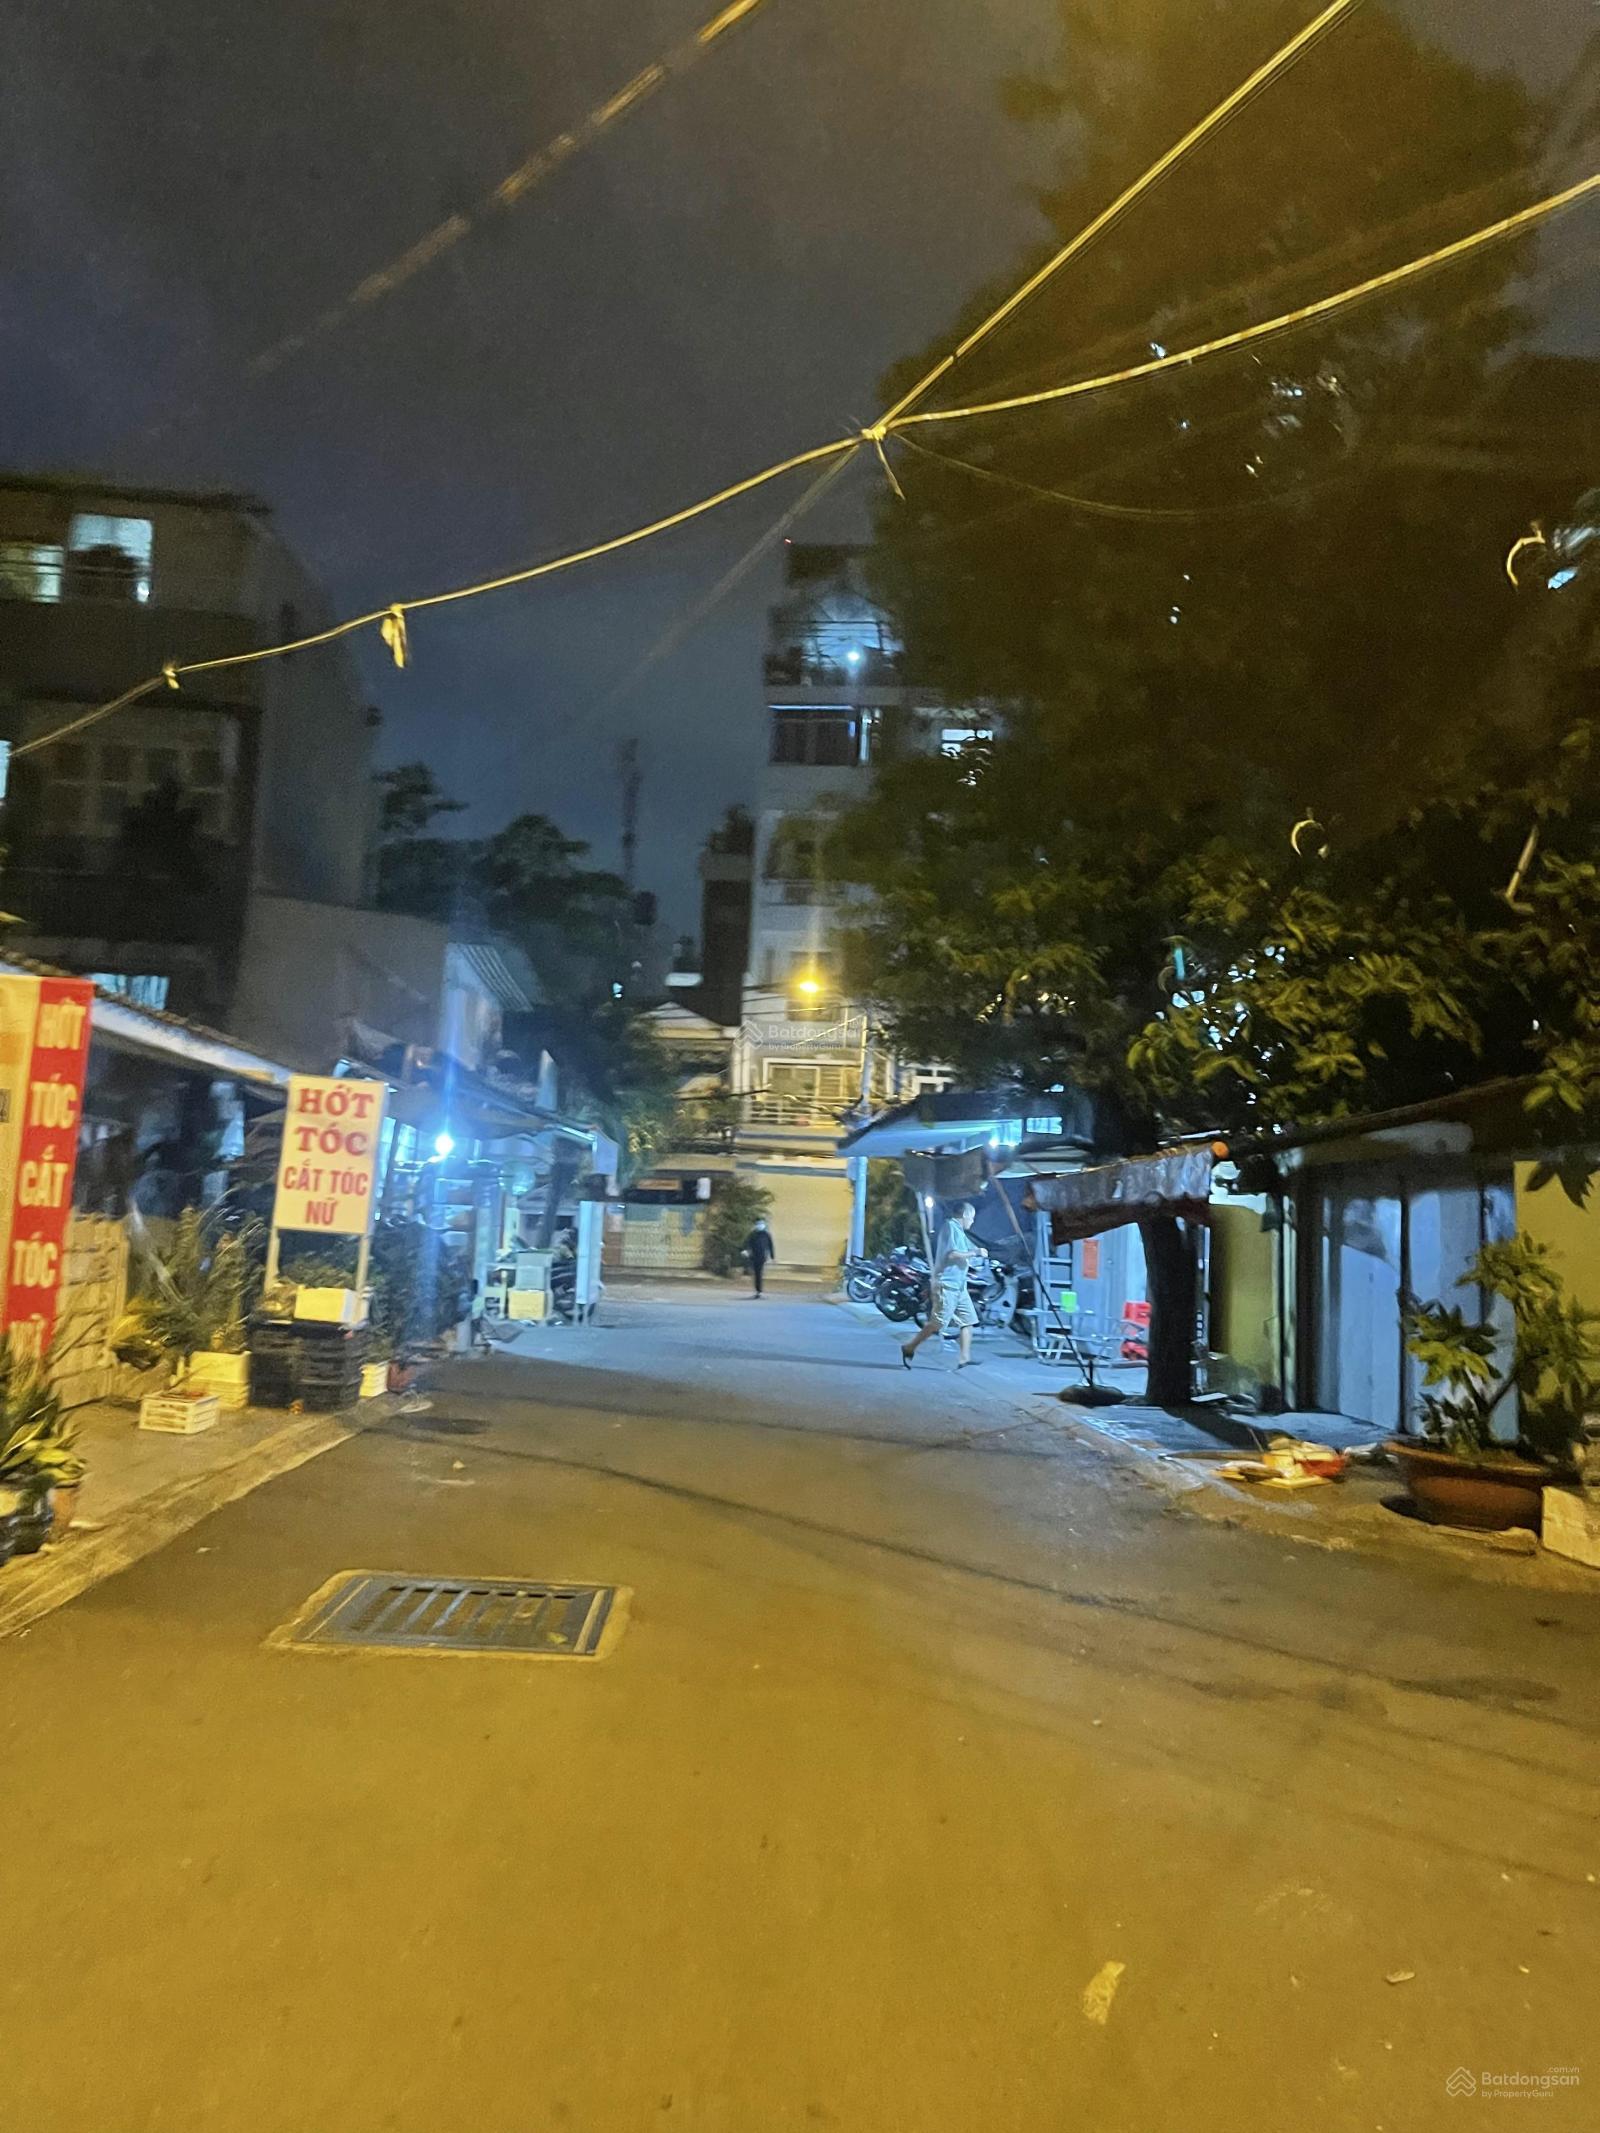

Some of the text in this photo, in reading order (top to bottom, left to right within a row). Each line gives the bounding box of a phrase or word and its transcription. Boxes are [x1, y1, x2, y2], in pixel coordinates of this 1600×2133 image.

[30, 1072, 77, 1129] TÓC
[297, 1083, 374, 1118] HỚT
[294, 1122, 367, 1156] TÓC
[283, 1159, 369, 1196] CẮT TÓC
[305, 1197, 338, 1226] NỮ
[12, 1231, 58, 1288] TÓC
